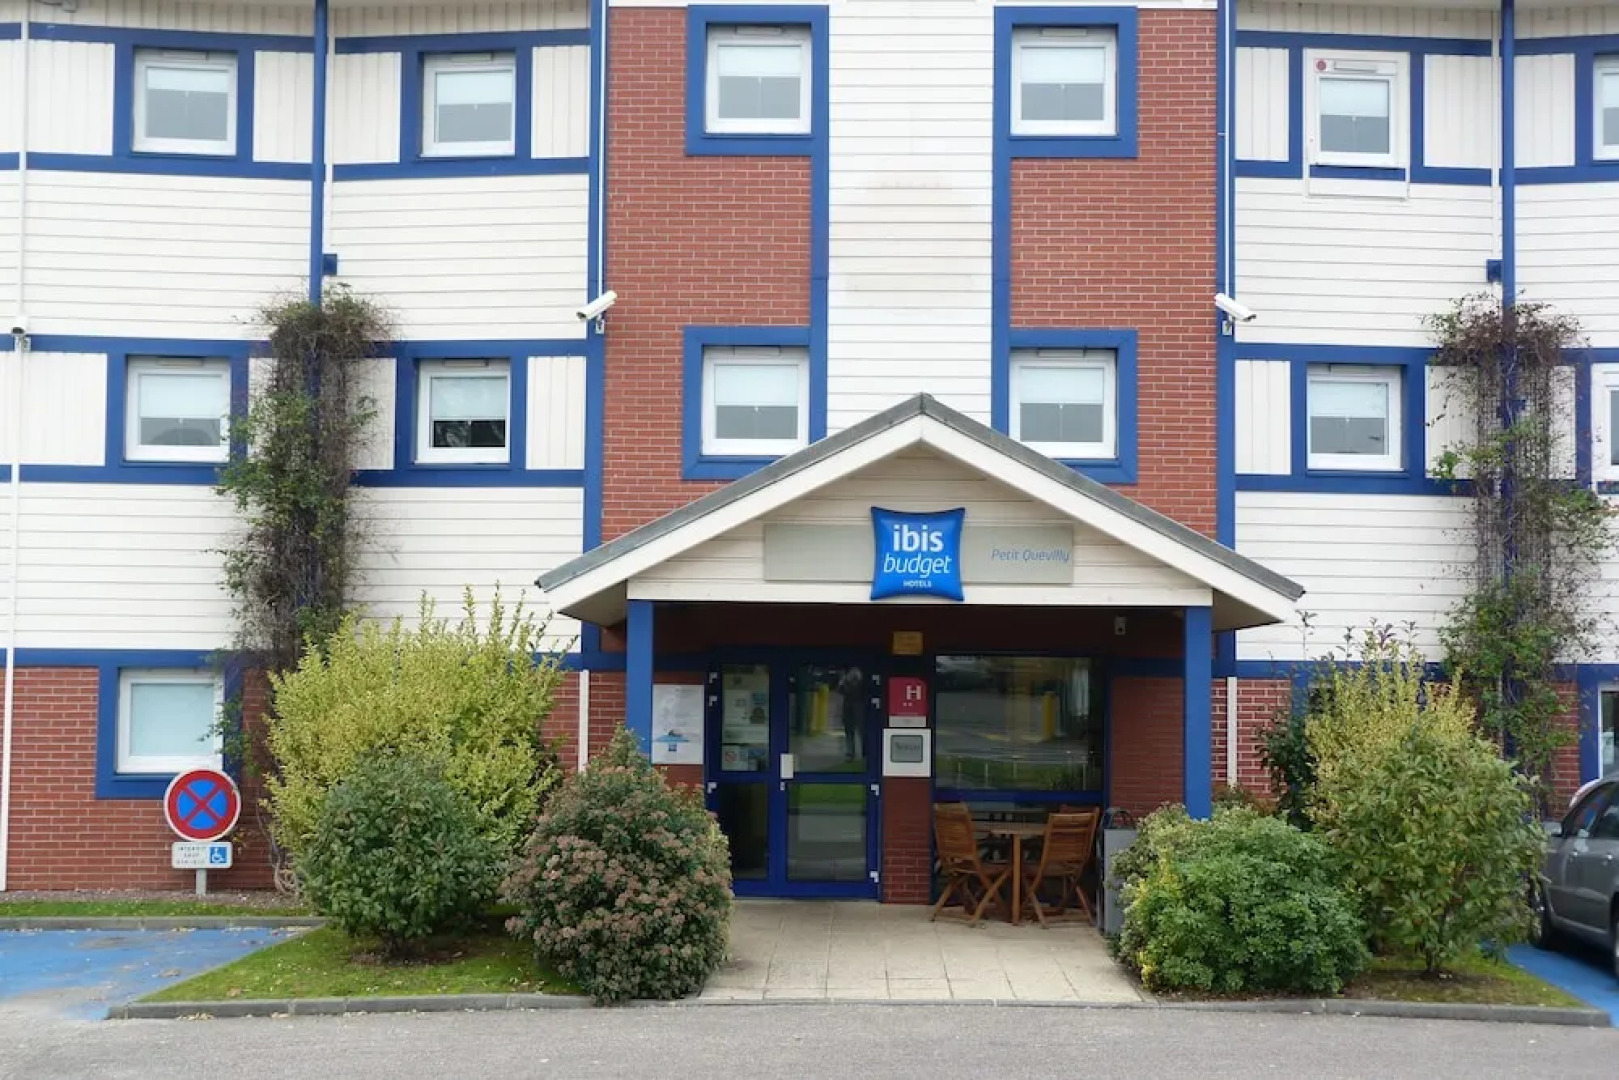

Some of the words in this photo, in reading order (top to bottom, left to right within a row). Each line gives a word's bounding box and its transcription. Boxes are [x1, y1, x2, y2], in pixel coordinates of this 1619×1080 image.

[893, 524, 944, 552] ibis
[992, 548, 1021, 561] Petit
[1023, 548, 1070, 563] Quevilly
[883, 552, 952, 579] budget
[903, 580, 932, 588] HOTELS
[906, 685, 922, 701] H
